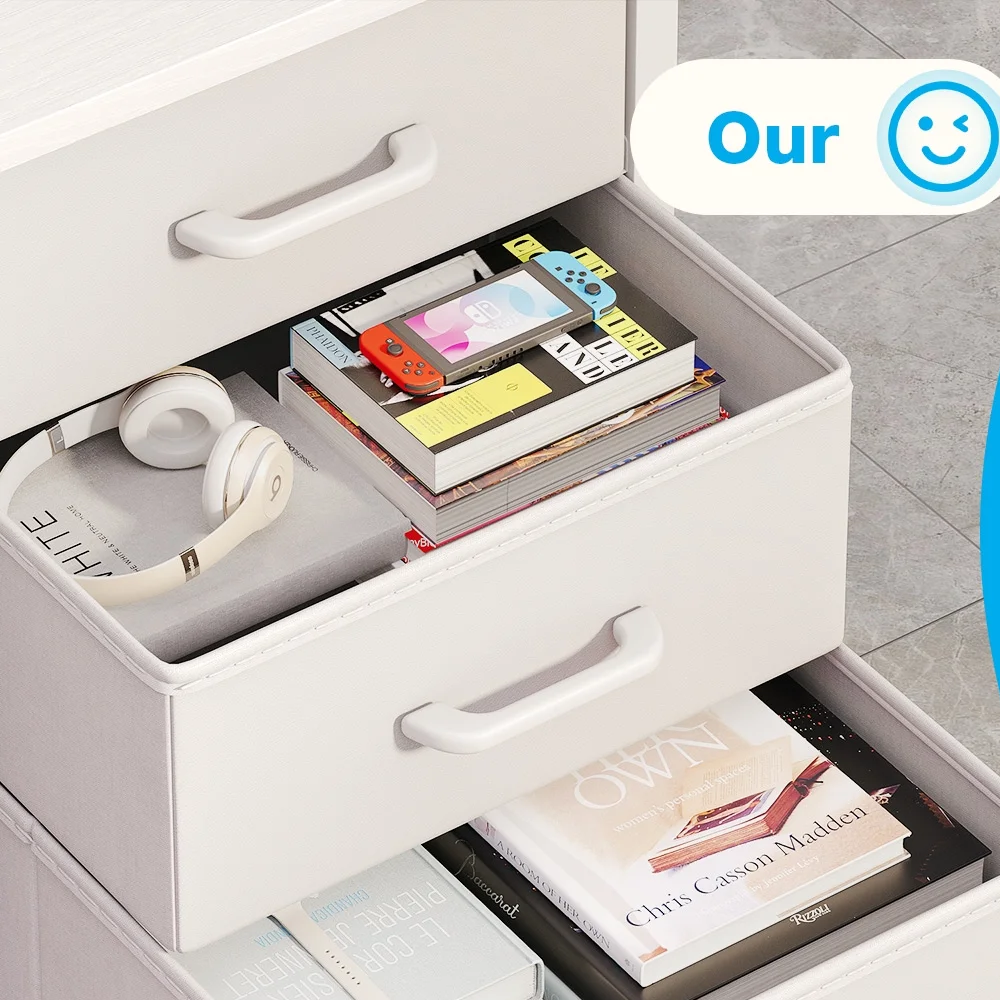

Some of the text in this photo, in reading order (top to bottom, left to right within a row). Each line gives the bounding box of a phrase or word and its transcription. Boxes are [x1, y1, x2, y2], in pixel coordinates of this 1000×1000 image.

[574, 721, 730, 810] OWN
[612, 763, 752, 834] women's personal spaces
[455, 839, 520, 920] Baccarat
[497, 840, 611, 949] A ROOM OF HER OWN
[626, 892, 692, 928] Chris
[694, 853, 774, 895] Casson
[774, 804, 869, 856] Madden
[354, 880, 447, 936] PIERRE
[408, 917, 450, 948] LE
